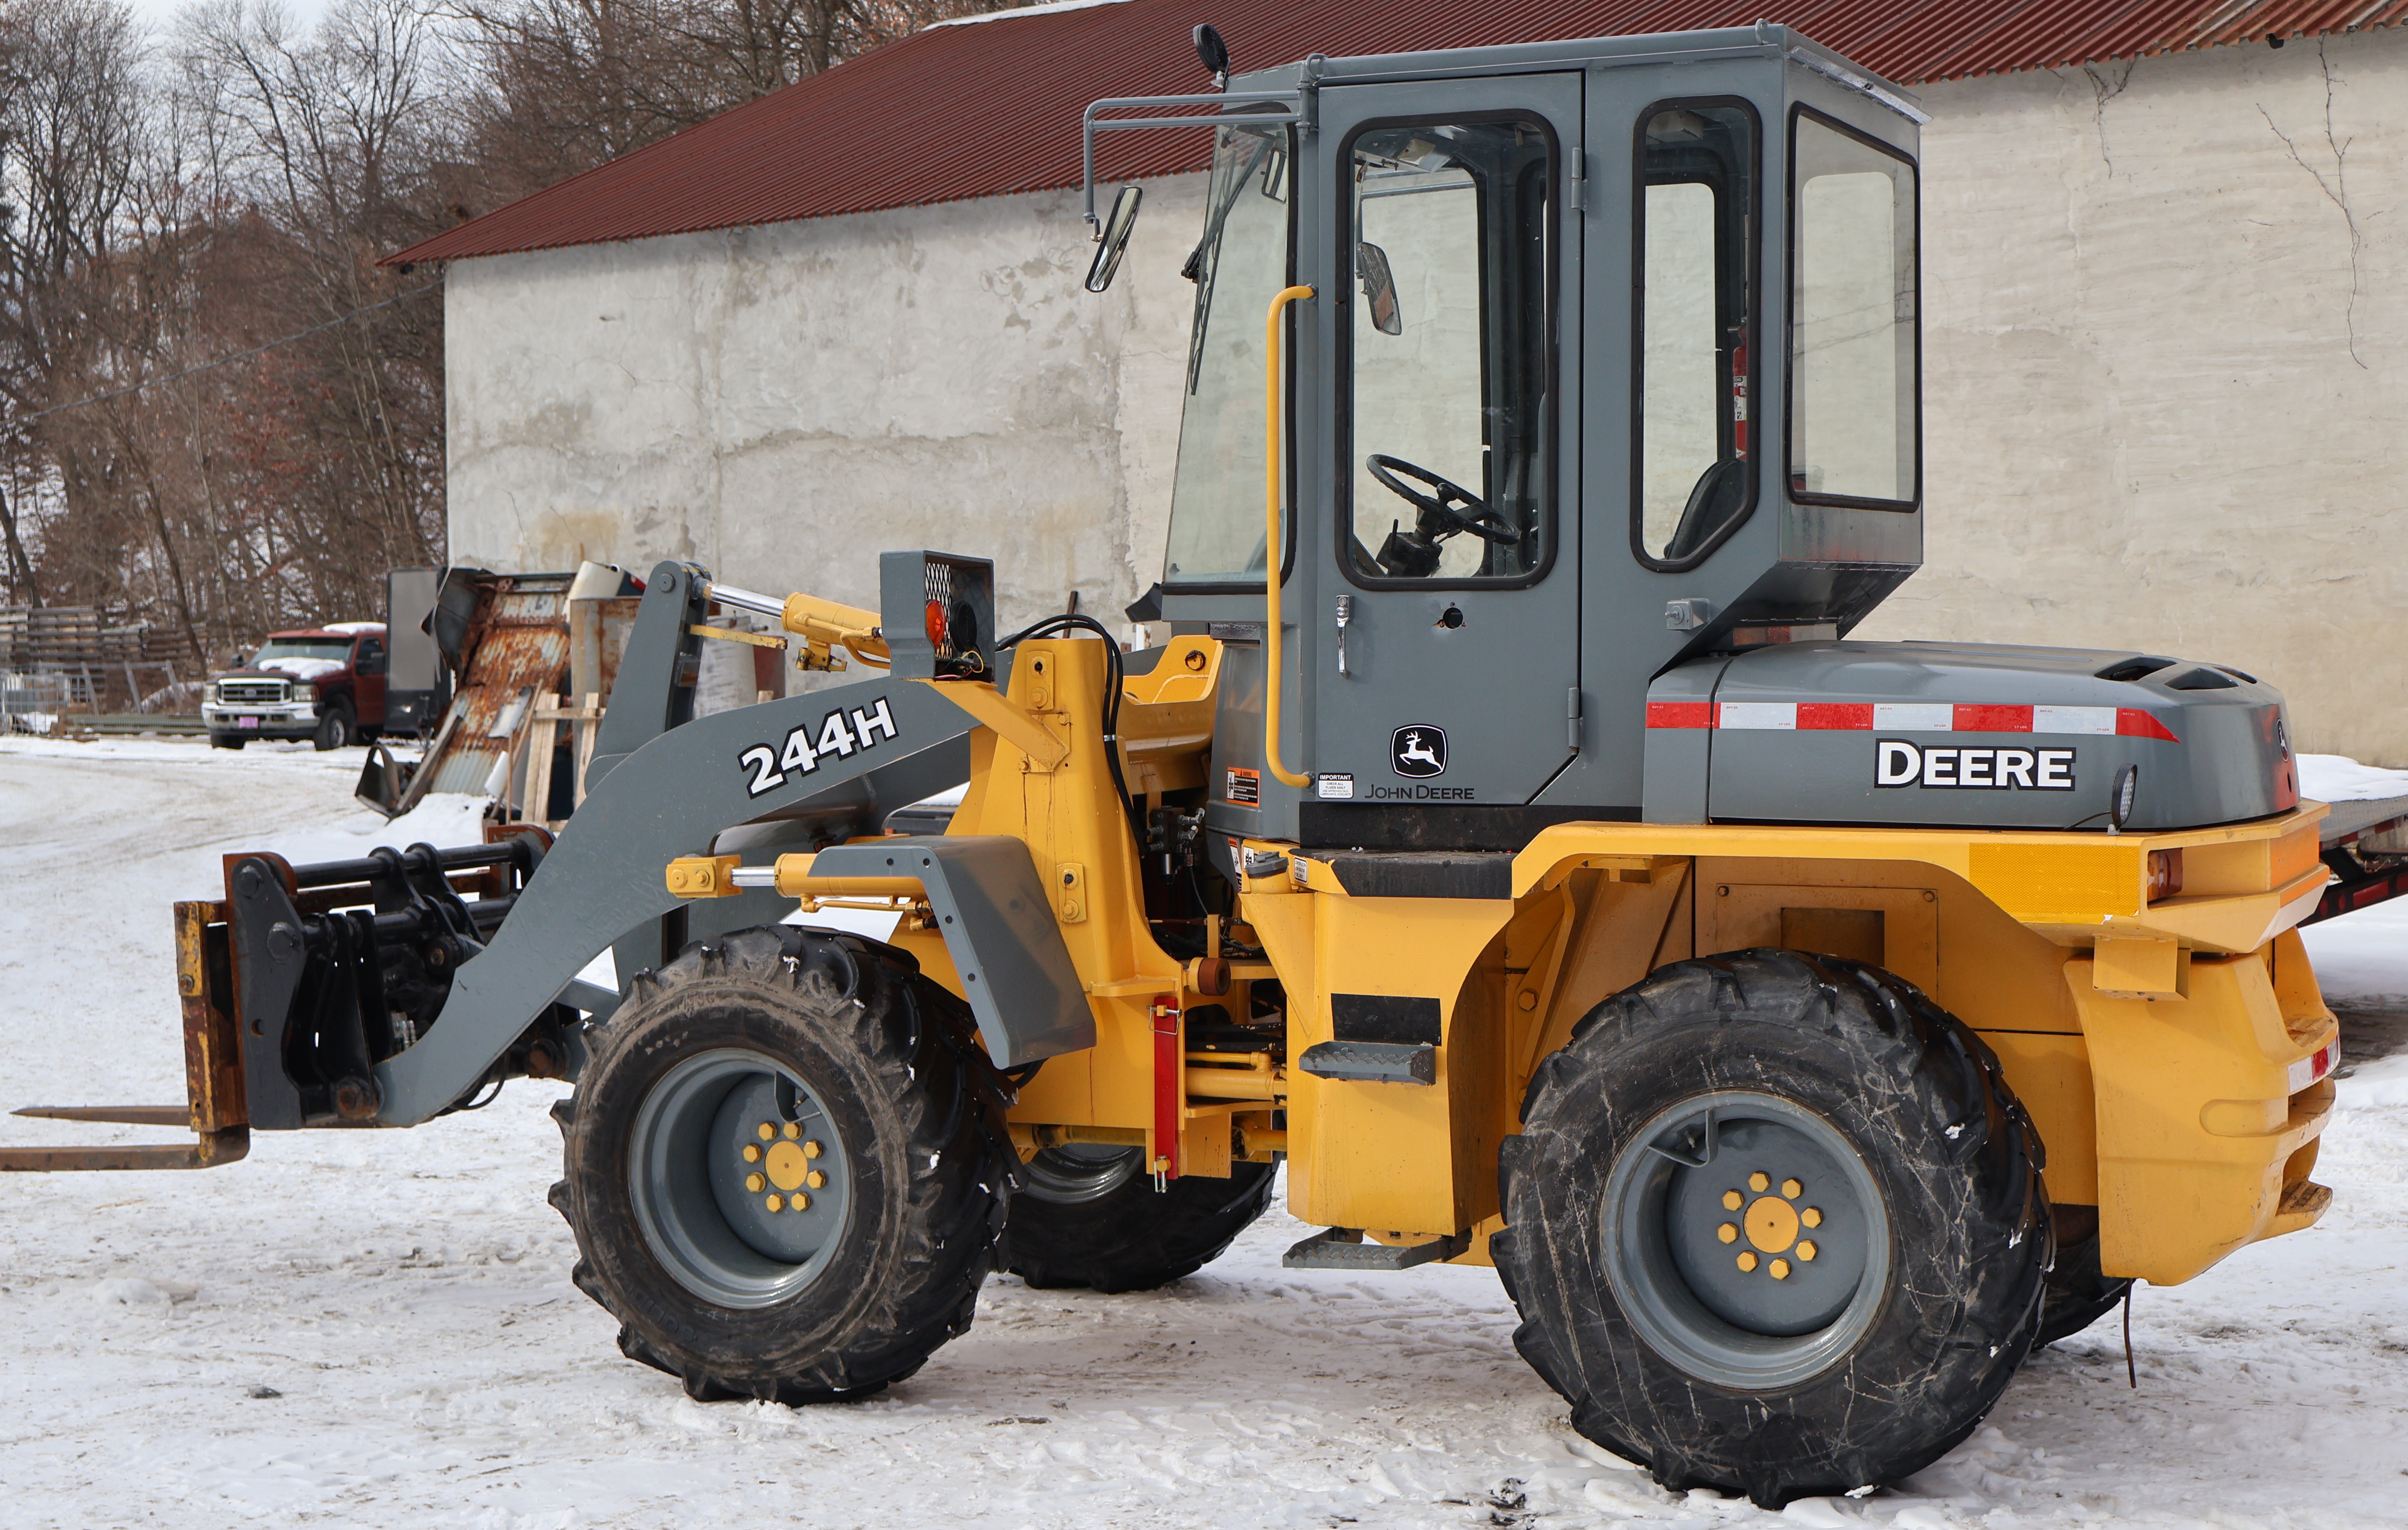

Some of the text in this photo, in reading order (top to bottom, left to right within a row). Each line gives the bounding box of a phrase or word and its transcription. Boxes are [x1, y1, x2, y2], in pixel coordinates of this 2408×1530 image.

[739, 697, 898, 798] 244H
[1876, 740, 2074, 789] DEERE
[1365, 784, 1474, 800] JOHN DEERE
